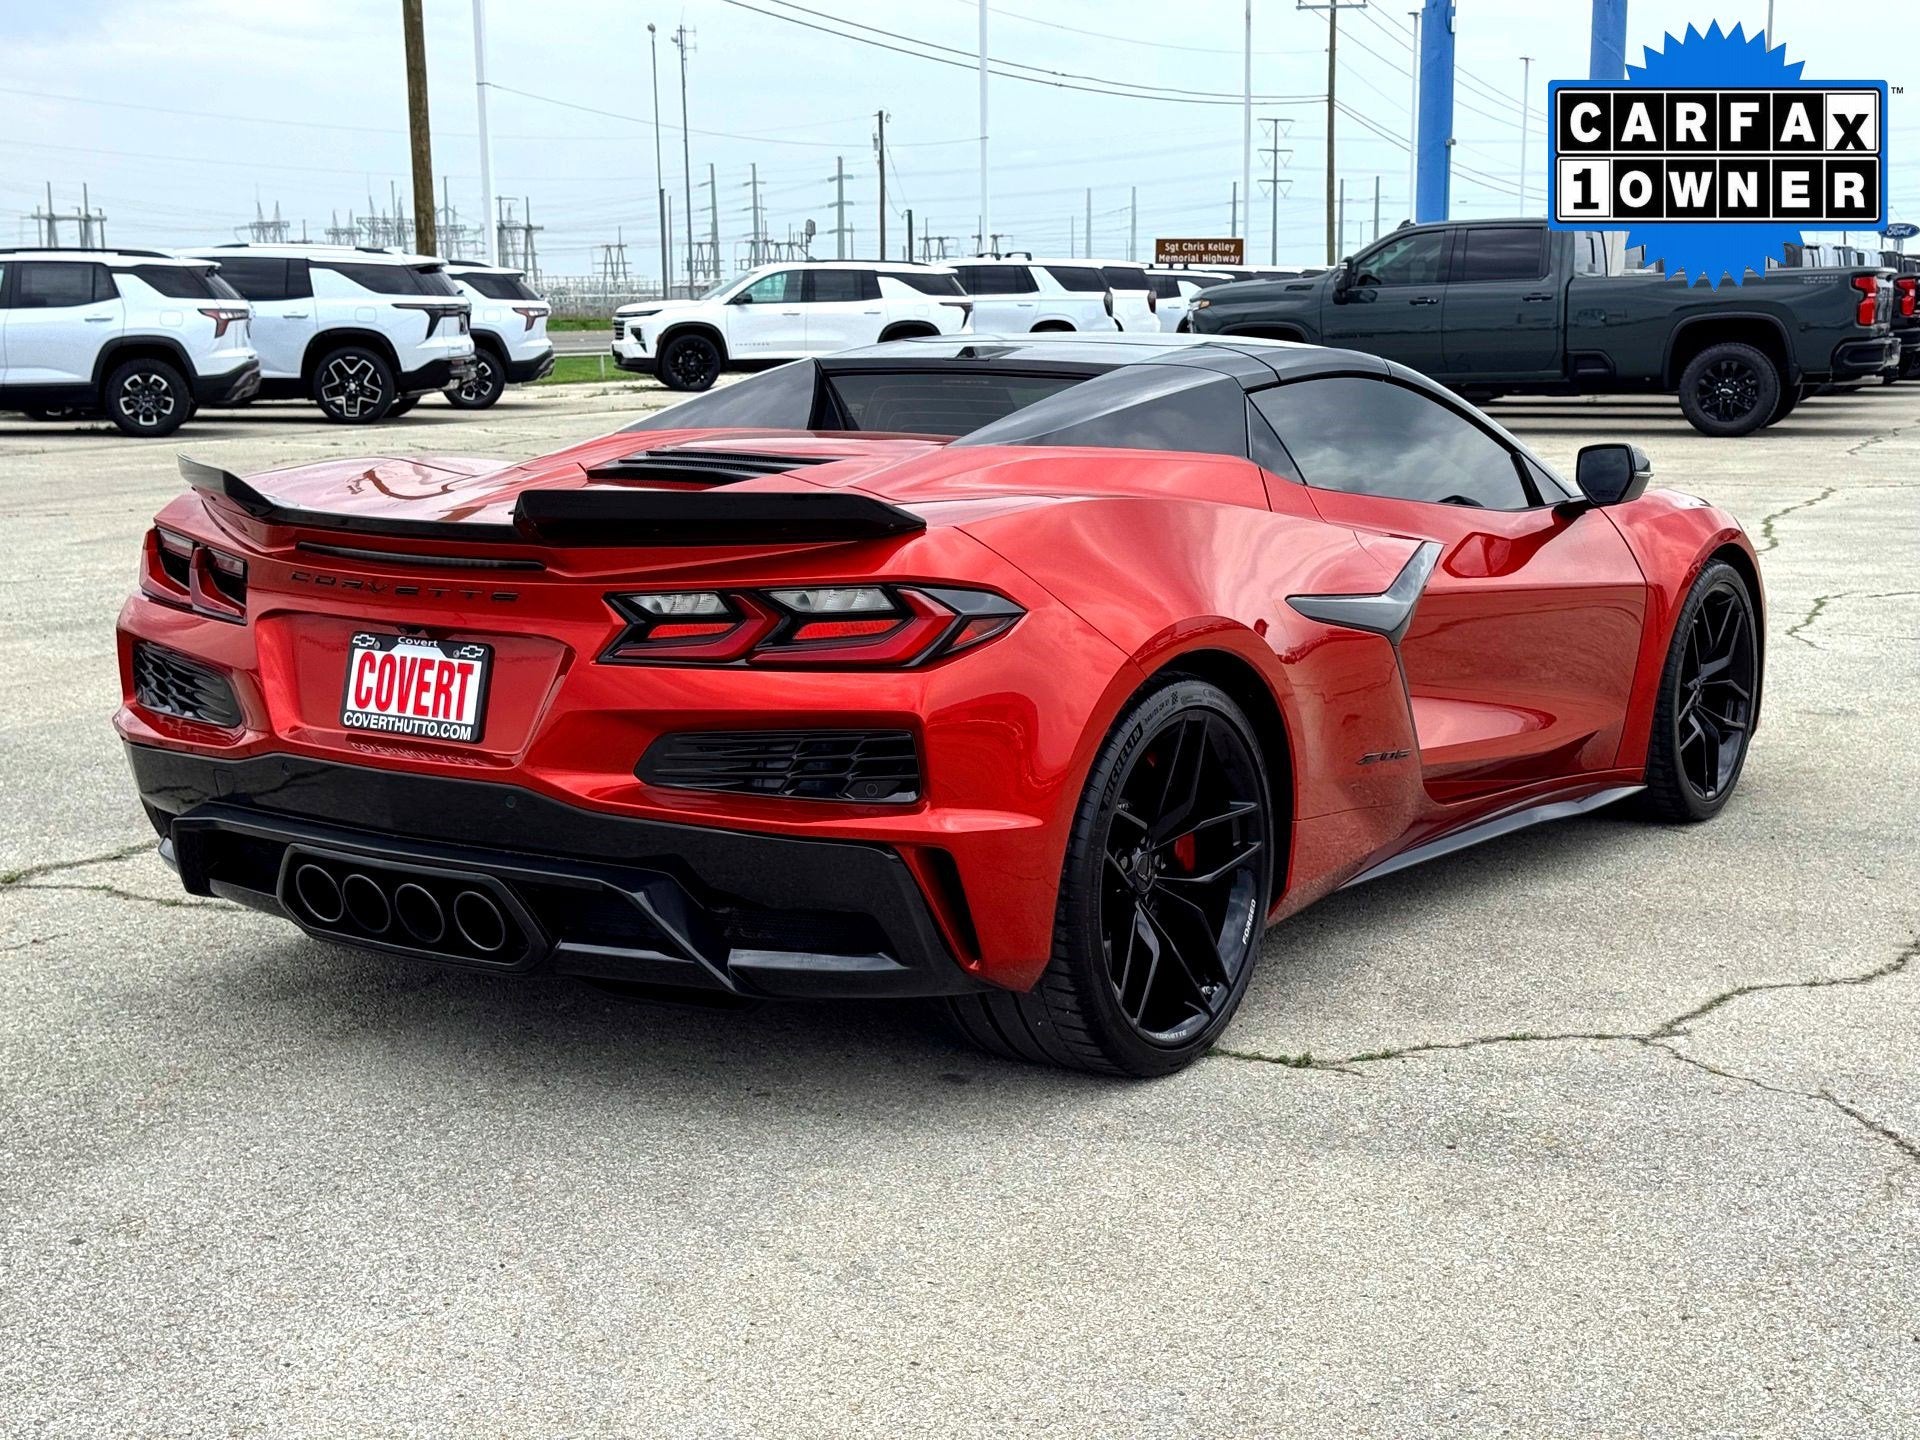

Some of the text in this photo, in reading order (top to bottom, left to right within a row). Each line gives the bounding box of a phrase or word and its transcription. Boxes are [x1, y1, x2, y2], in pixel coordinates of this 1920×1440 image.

[1158, 254, 1240, 264] Memorial Highway
[1164, 242, 1236, 253] Sgt Chris Kelley
[291, 571, 520, 602] CORVETTE
[397, 636, 438, 647] Covert
[354, 651, 475, 722] COVERT
[343, 711, 472, 741] COVERTHUTTO.COM
[1102, 726, 1142, 807] MICHELIN
[1242, 898, 1256, 945] FORGED
